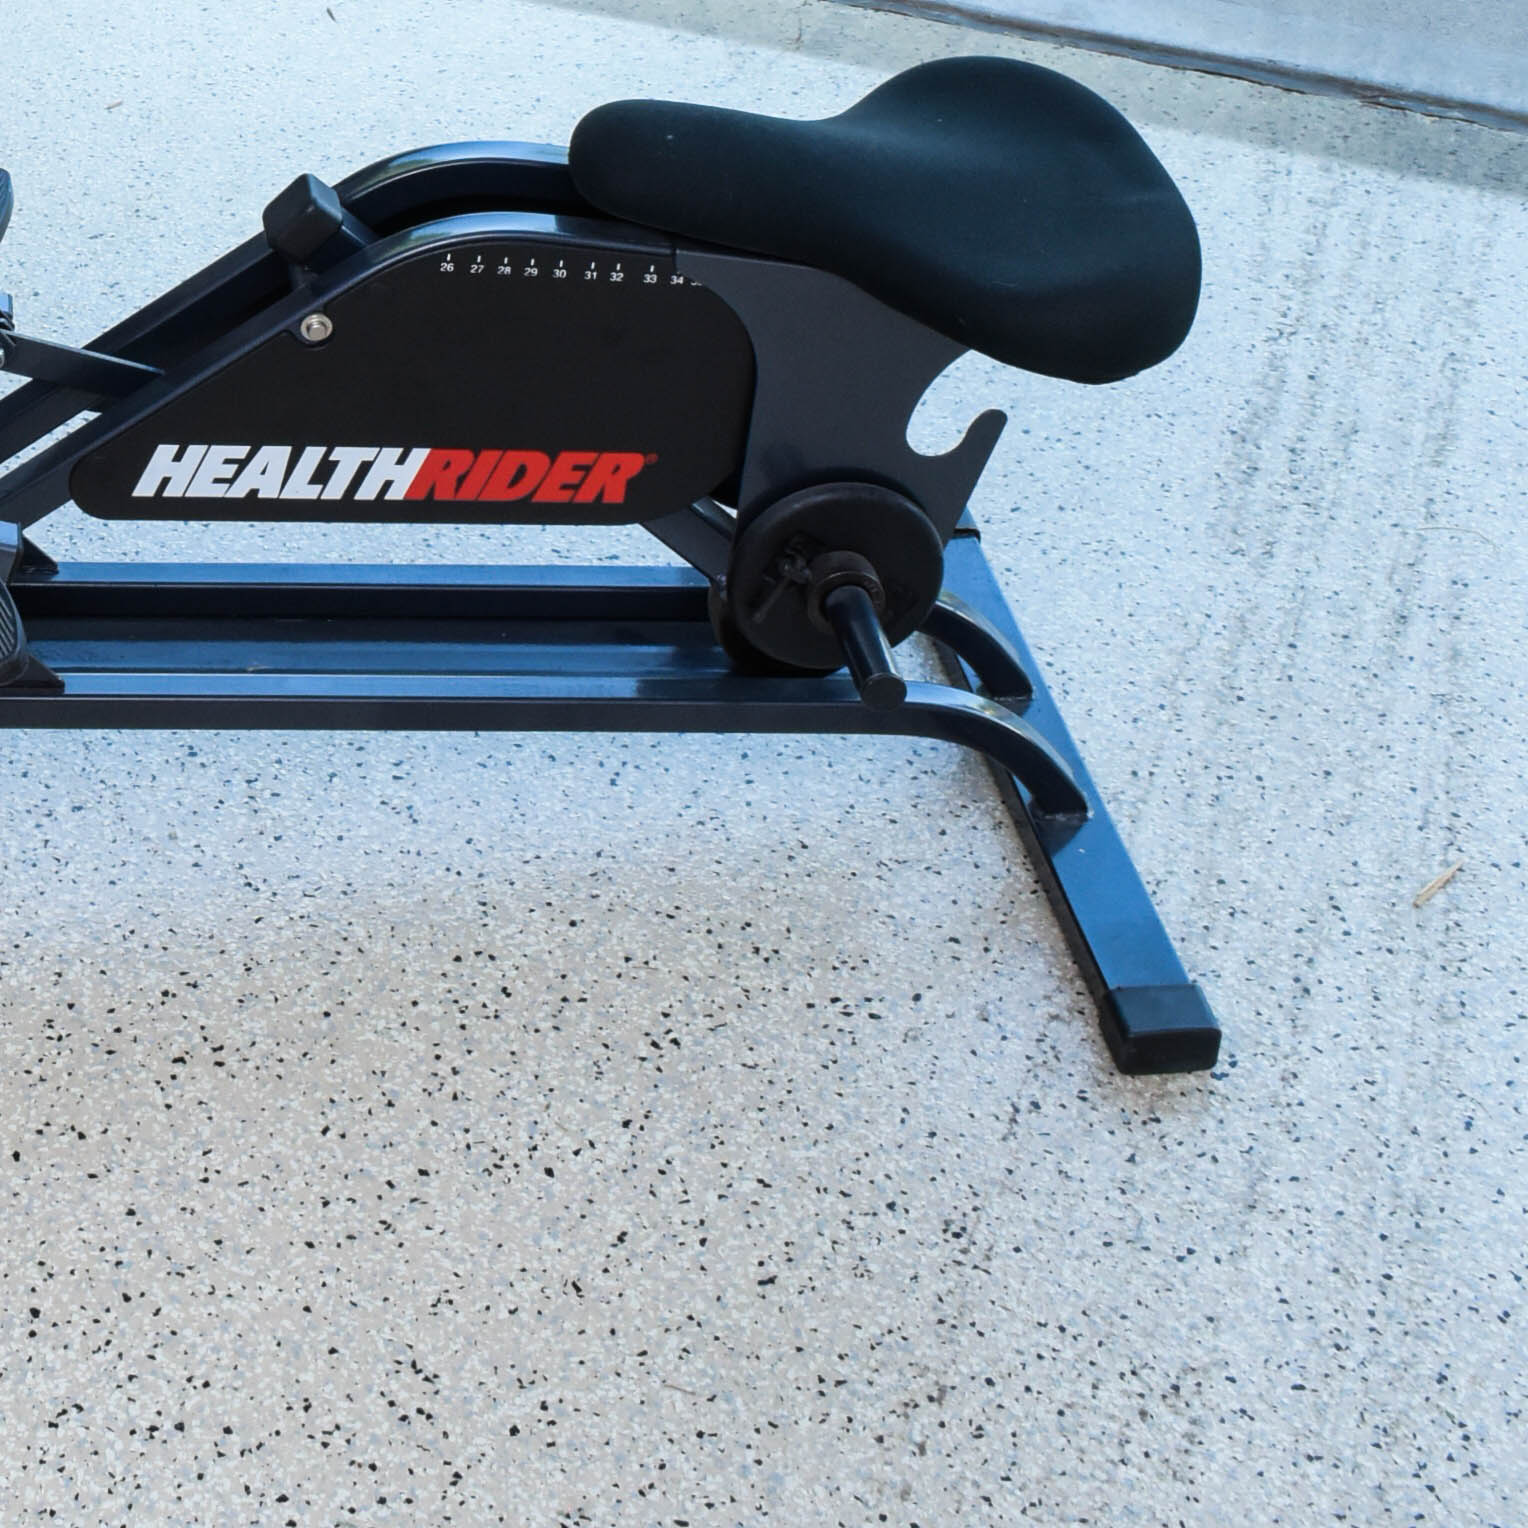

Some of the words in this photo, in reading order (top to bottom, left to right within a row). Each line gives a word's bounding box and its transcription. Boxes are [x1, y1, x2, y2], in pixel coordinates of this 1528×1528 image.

[439, 262, 455, 273] 26
[469, 264, 485, 274] 27
[496, 265, 512, 276] 28
[523, 267, 538, 277] 29
[552, 268, 567, 279] 30
[584, 270, 598, 281] 31
[609, 271, 624, 282] 32
[643, 273, 658, 284] 33
[670, 275, 684, 285] 34
[131, 444, 645, 504] HEALTHRIDER
